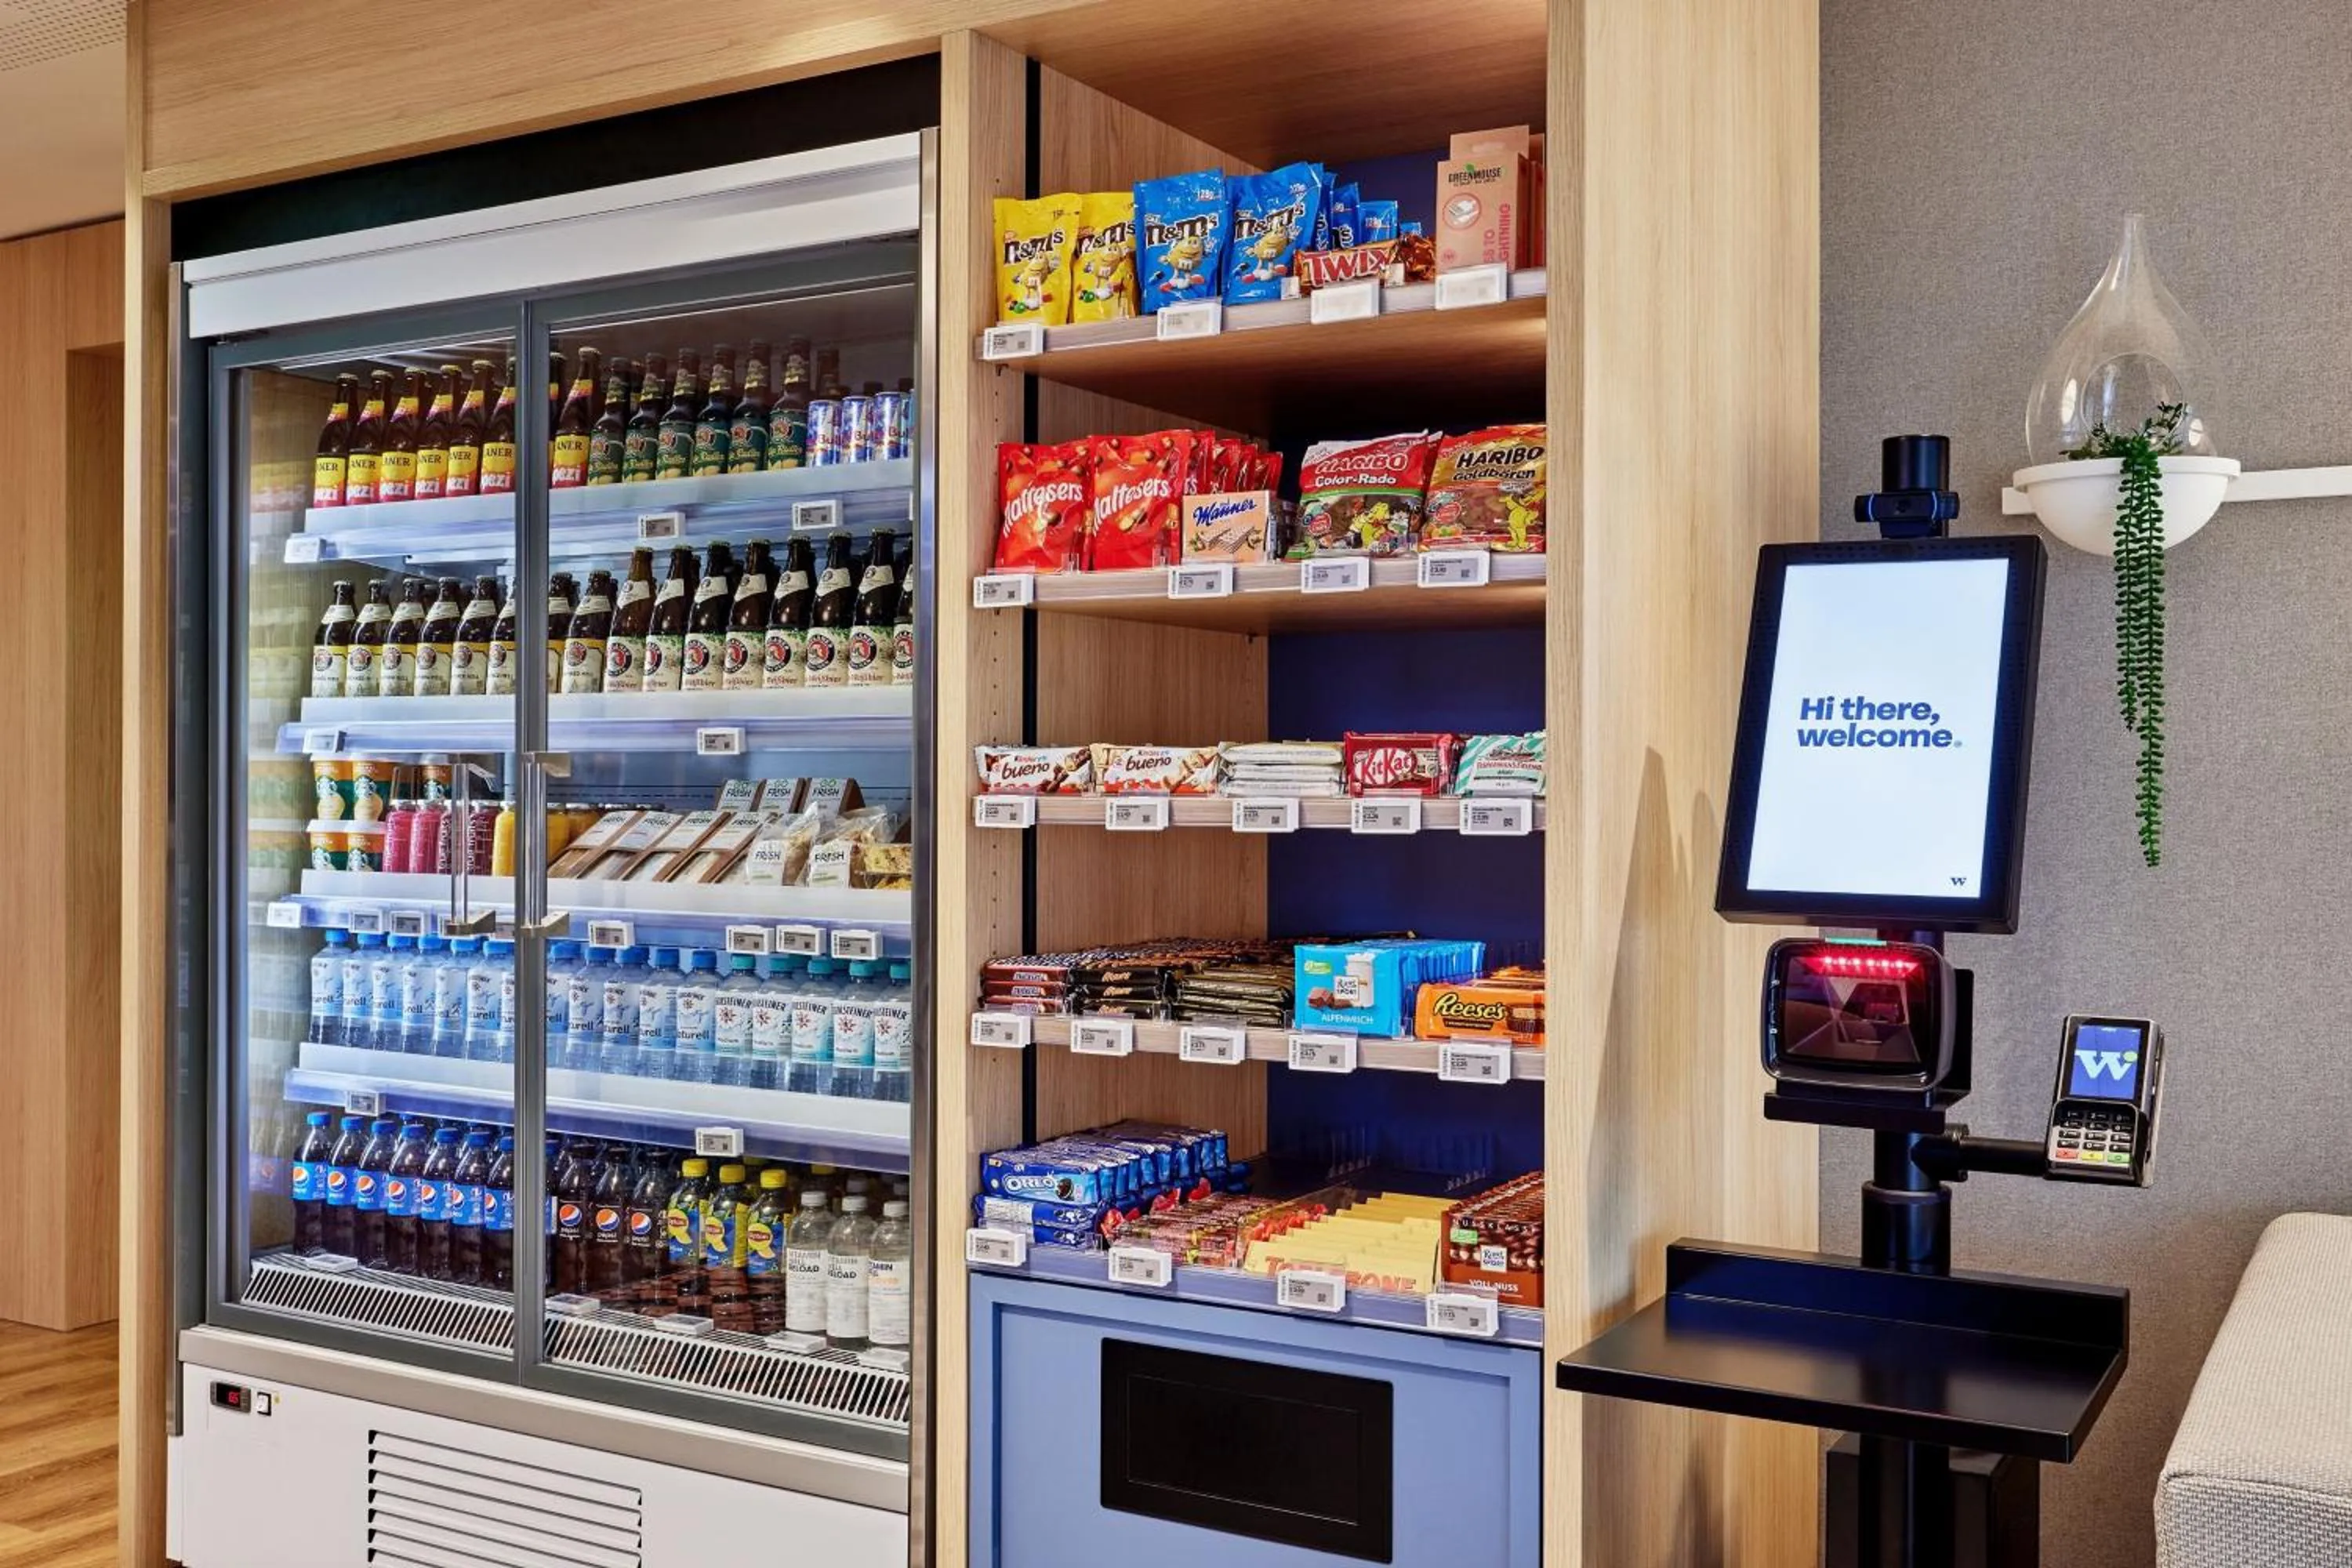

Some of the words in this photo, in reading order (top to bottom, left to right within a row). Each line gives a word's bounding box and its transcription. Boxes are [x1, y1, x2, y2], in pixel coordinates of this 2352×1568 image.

[1304, 249, 1390, 287] TWIX
[1315, 452, 1409, 474] HARIBO
[1455, 445, 1545, 468] HARIBO
[1315, 473, 1396, 488] Color-Rado
[1192, 498, 1257, 526] Manner
[1800, 696, 1835, 720] Hi
[1841, 695, 1940, 726] there,
[1002, 762, 1051, 780] bueno
[1125, 755, 1173, 772] bueno
[1361, 749, 1411, 785] KitKat
[1435, 992, 1508, 1020] Reese's
[1006, 1174, 1054, 1192] OREO
